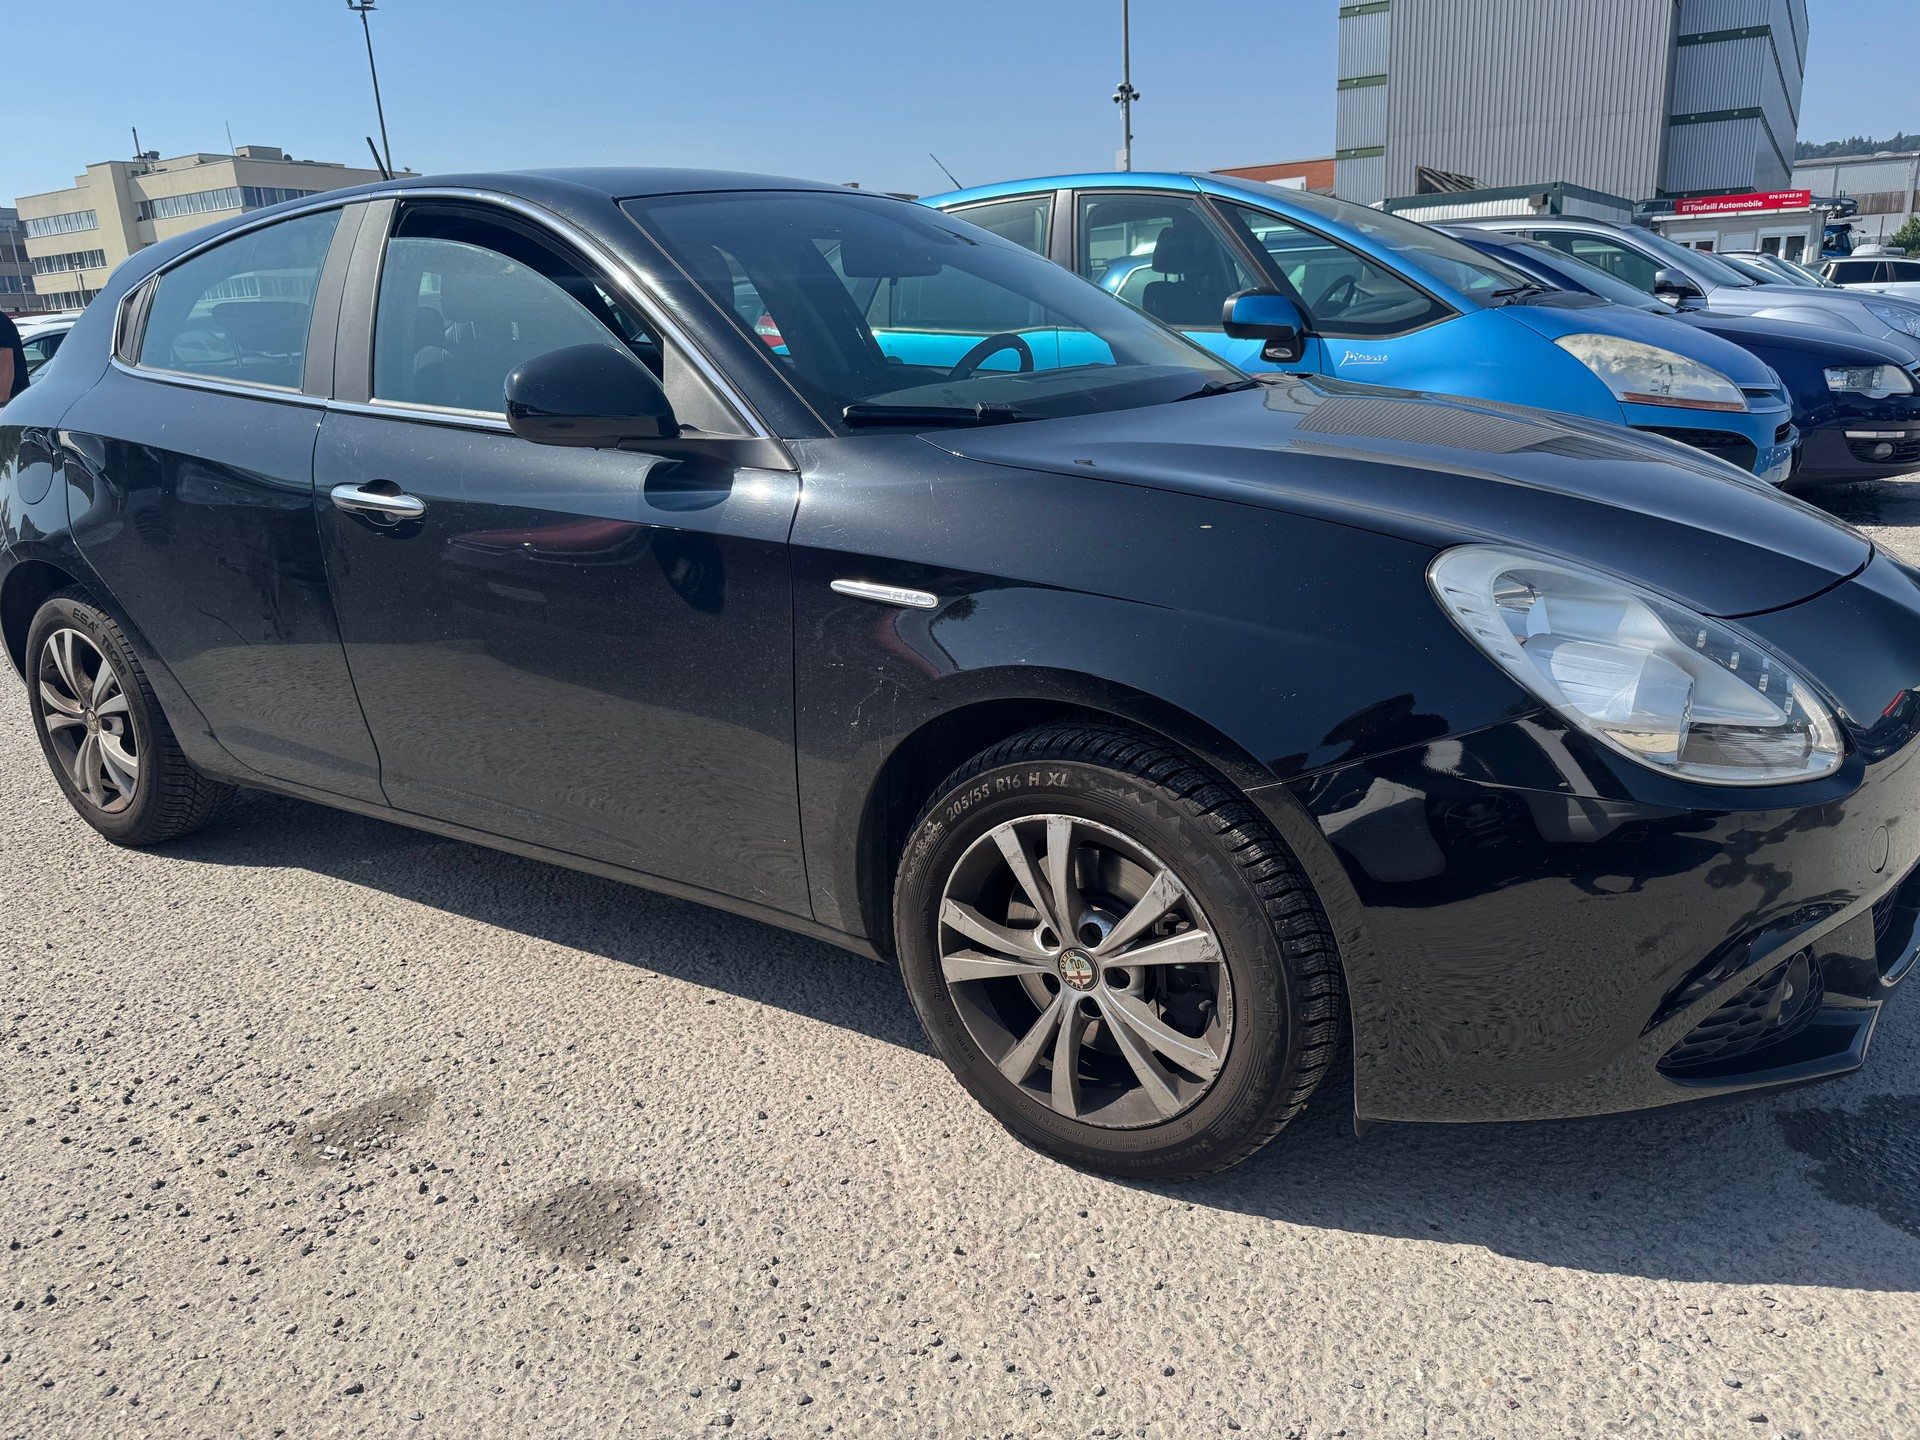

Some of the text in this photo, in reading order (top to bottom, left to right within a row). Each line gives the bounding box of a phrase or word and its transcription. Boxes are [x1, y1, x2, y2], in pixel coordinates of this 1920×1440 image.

[1718, 200, 1763, 210] Automobile
[101, 634, 127, 678] TECAR
[946, 771, 1069, 822] 205/55 R16 H XL
